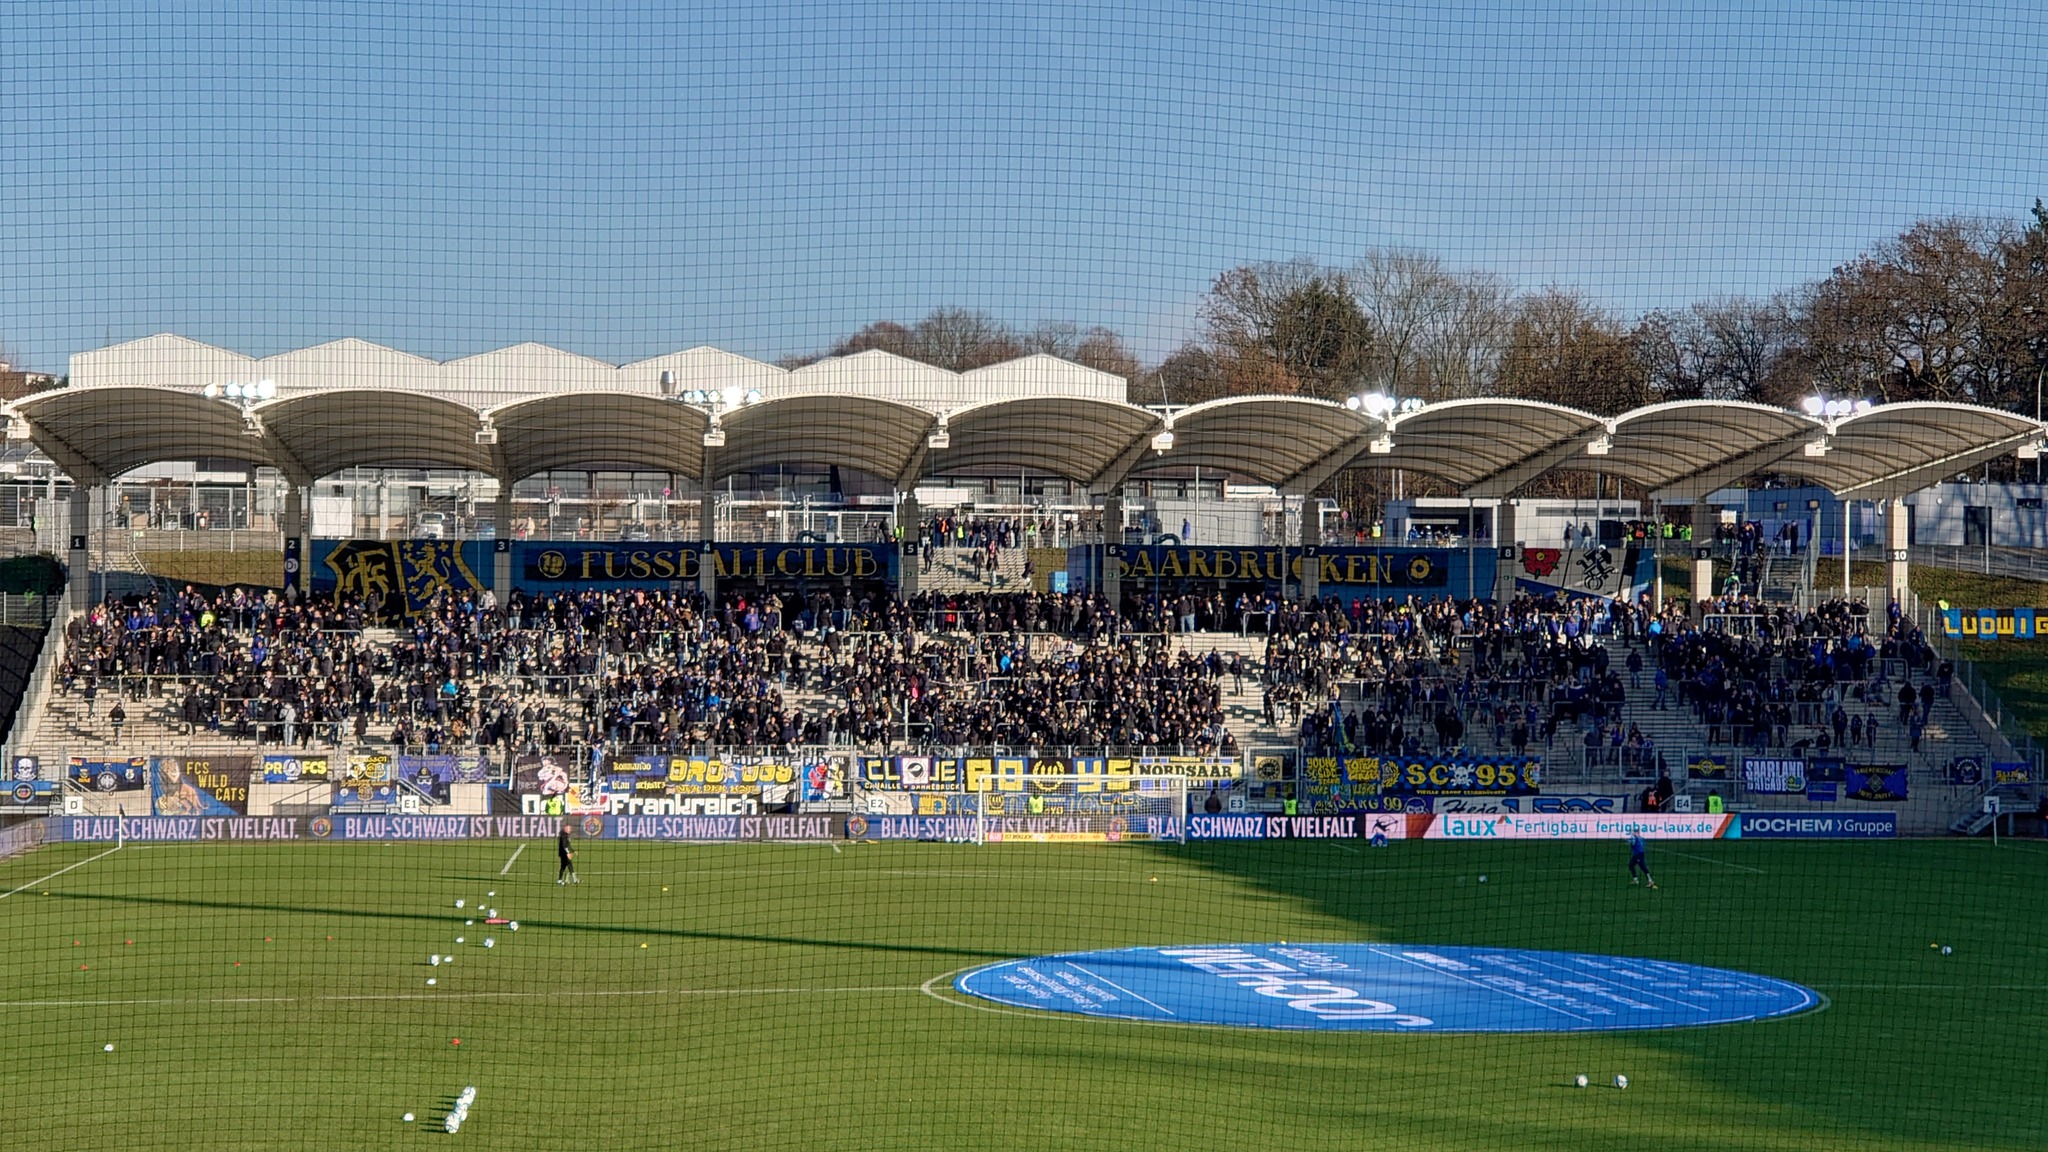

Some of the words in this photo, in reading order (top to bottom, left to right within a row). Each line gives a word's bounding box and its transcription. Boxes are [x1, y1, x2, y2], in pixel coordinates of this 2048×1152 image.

[74, 538, 80, 547] 1
[288, 540, 295, 549] 2
[498, 542, 505, 550] 3
[704, 543, 711, 552] 4
[907, 545, 914, 553] 5
[1109, 546, 1116, 554] 6
[1308, 547, 1315, 556] 7
[1505, 548, 1511, 557] 8
[1701, 550, 1708, 559] 9
[1893, 550, 1907, 561] 10
[580, 548, 877, 579] FUSSBALLCLUB
[187, 761, 209, 775] FCS
[302, 760, 327, 774] FCS
[1139, 764, 1233, 778] NORDSAAR
[1745, 760, 1804, 780] SAARLAND
[198, 775, 227, 788] WILD
[1406, 764, 1449, 785] SC
[1475, 764, 1517, 786] 95
[215, 787, 246, 801] CATS
[70, 801, 78, 810] D
[404, 799, 417, 809] E1
[870, 799, 884, 808] E2
[1230, 799, 1243, 809] E3
[1676, 799, 1689, 809] E4
[73, 818, 196, 840] BLAU-SCHWARZ
[202, 818, 225, 839] IST
[229, 818, 299, 839] VIELFALT.
[345, 817, 467, 838] BLAU-SCHWARZ
[471, 816, 492, 838] IST
[617, 817, 737, 838] BLAU-SCHWARZ
[740, 817, 762, 838] IST
[766, 817, 833, 839] VIELFALT.
[881, 817, 997, 839] BLAU-SCHWARZ
[1002, 817, 1023, 834] IST
[1147, 816, 1263, 838] BLAU-SCHWARZ
[1266, 816, 1289, 838] IST
[1291, 816, 1358, 838] VIELFALT.
[1443, 815, 1496, 836] laux
[1515, 819, 1588, 837] Fertigbau
[1596, 820, 1713, 836] fertigbau-laux.de
[1743, 818, 1832, 832] JOCHEM
[1844, 818, 1893, 836] Gruppe
[1157, 948, 1435, 1027] JOCHEM
